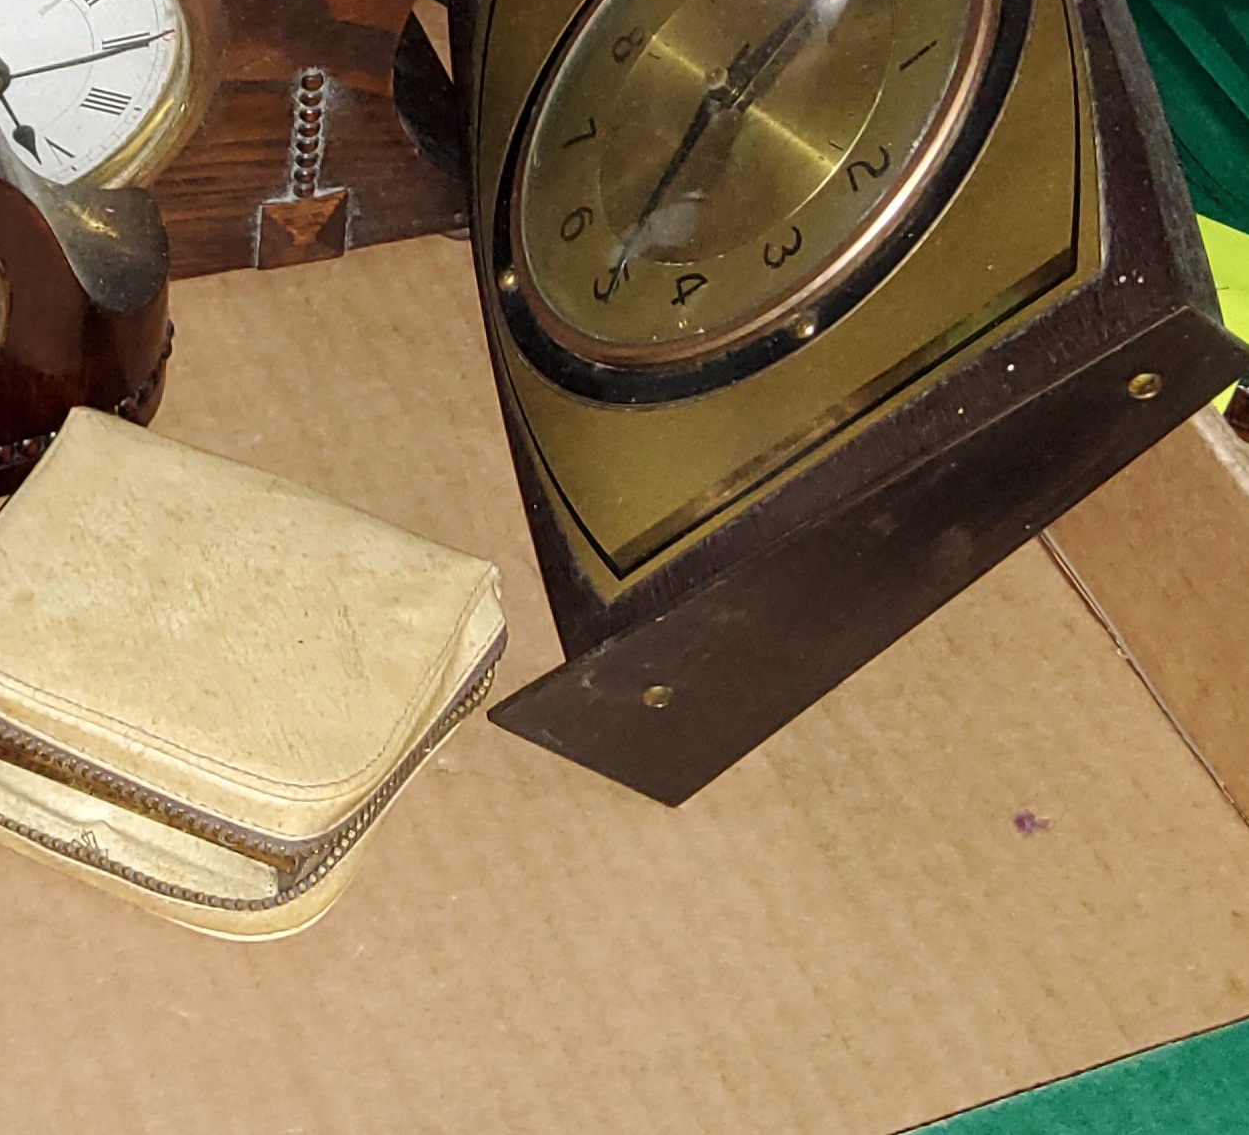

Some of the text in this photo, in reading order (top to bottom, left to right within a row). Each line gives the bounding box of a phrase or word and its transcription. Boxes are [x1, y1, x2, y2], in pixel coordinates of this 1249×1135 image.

[612, 26, 645, 63] 8
[563, 118, 597, 148] 7
[846, 144, 890, 192] 2
[560, 206, 594, 242] 6
[763, 226, 802, 269] 3
[671, 273, 708, 305] 4
